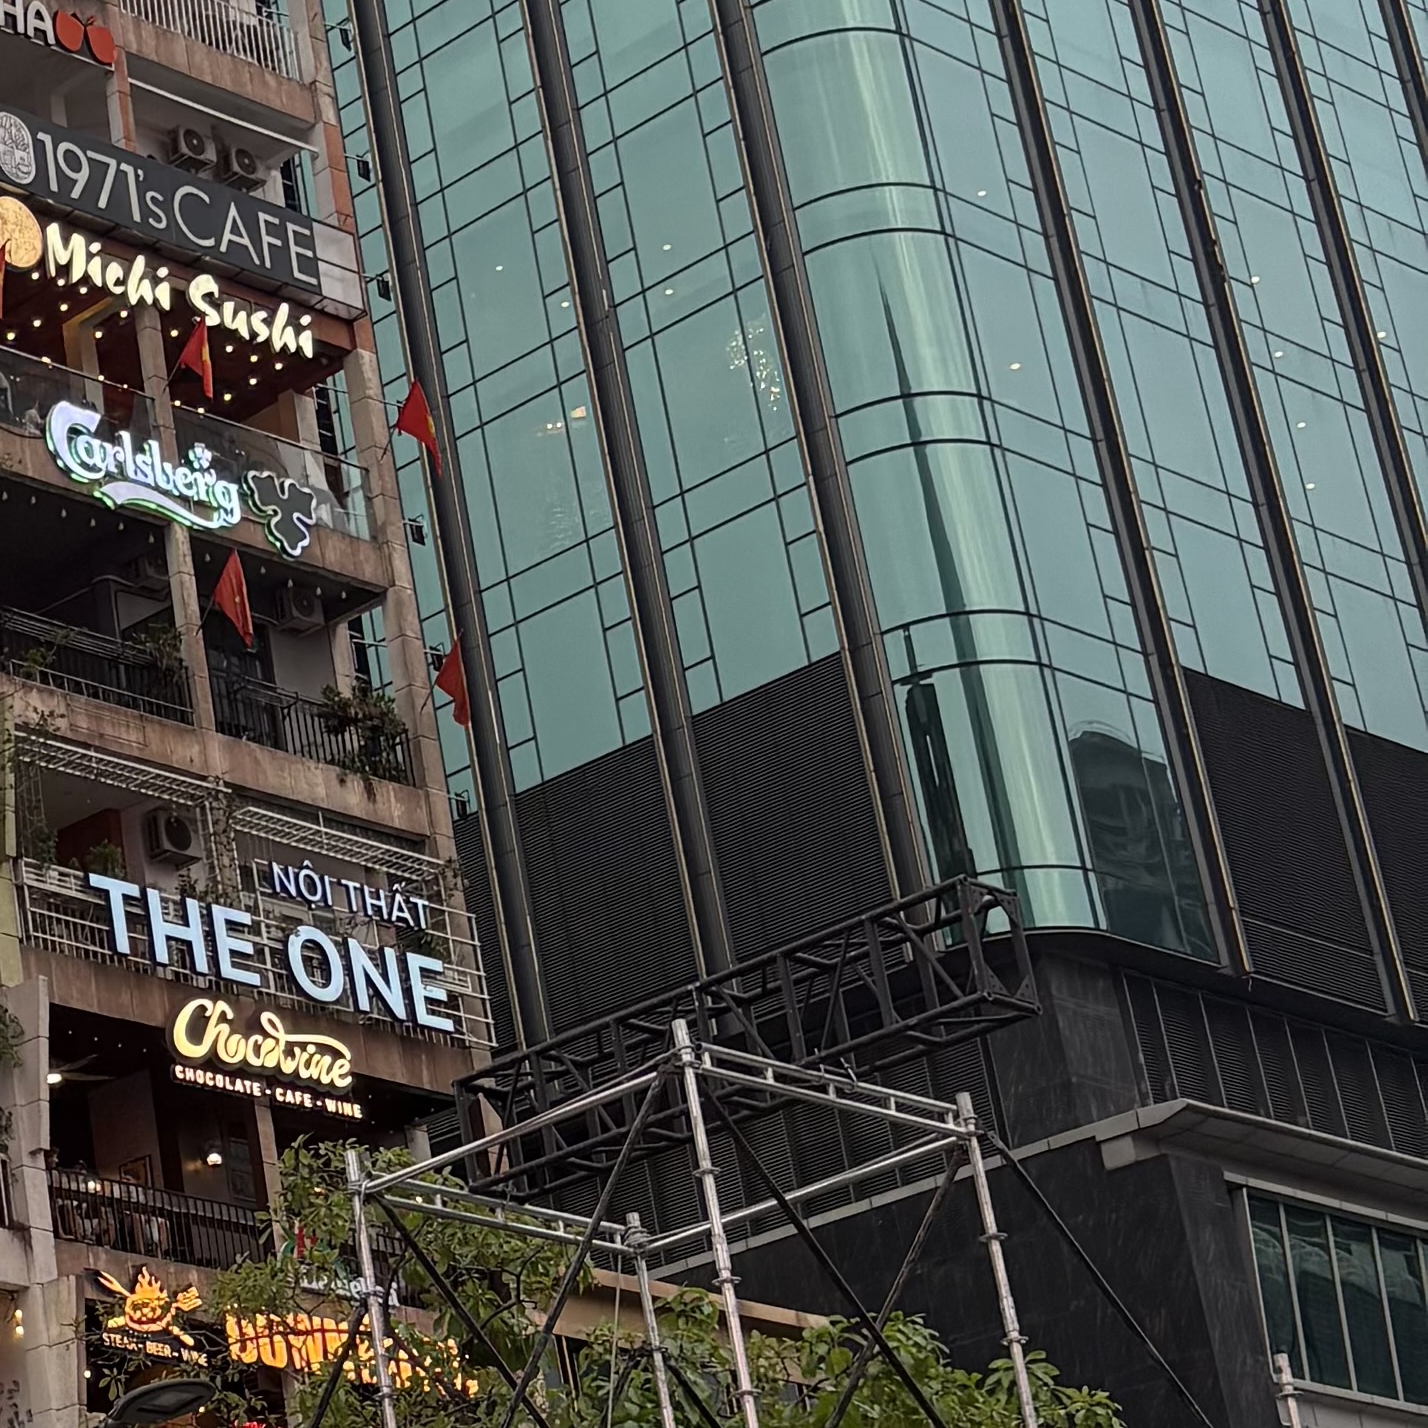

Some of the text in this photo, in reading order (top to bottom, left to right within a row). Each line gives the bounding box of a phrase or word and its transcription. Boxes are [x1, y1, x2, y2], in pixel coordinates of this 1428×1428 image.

[44, 221, 316, 360] Michi Sushi
[171, 185, 320, 287] CAFE
[44, 401, 243, 529] Carlsberg
[270, 859, 430, 931] NỘI THẤT
[88, 872, 456, 1034] THE ONE
[174, 1064, 363, 1119] CHOCOLATE CAFE WINE
